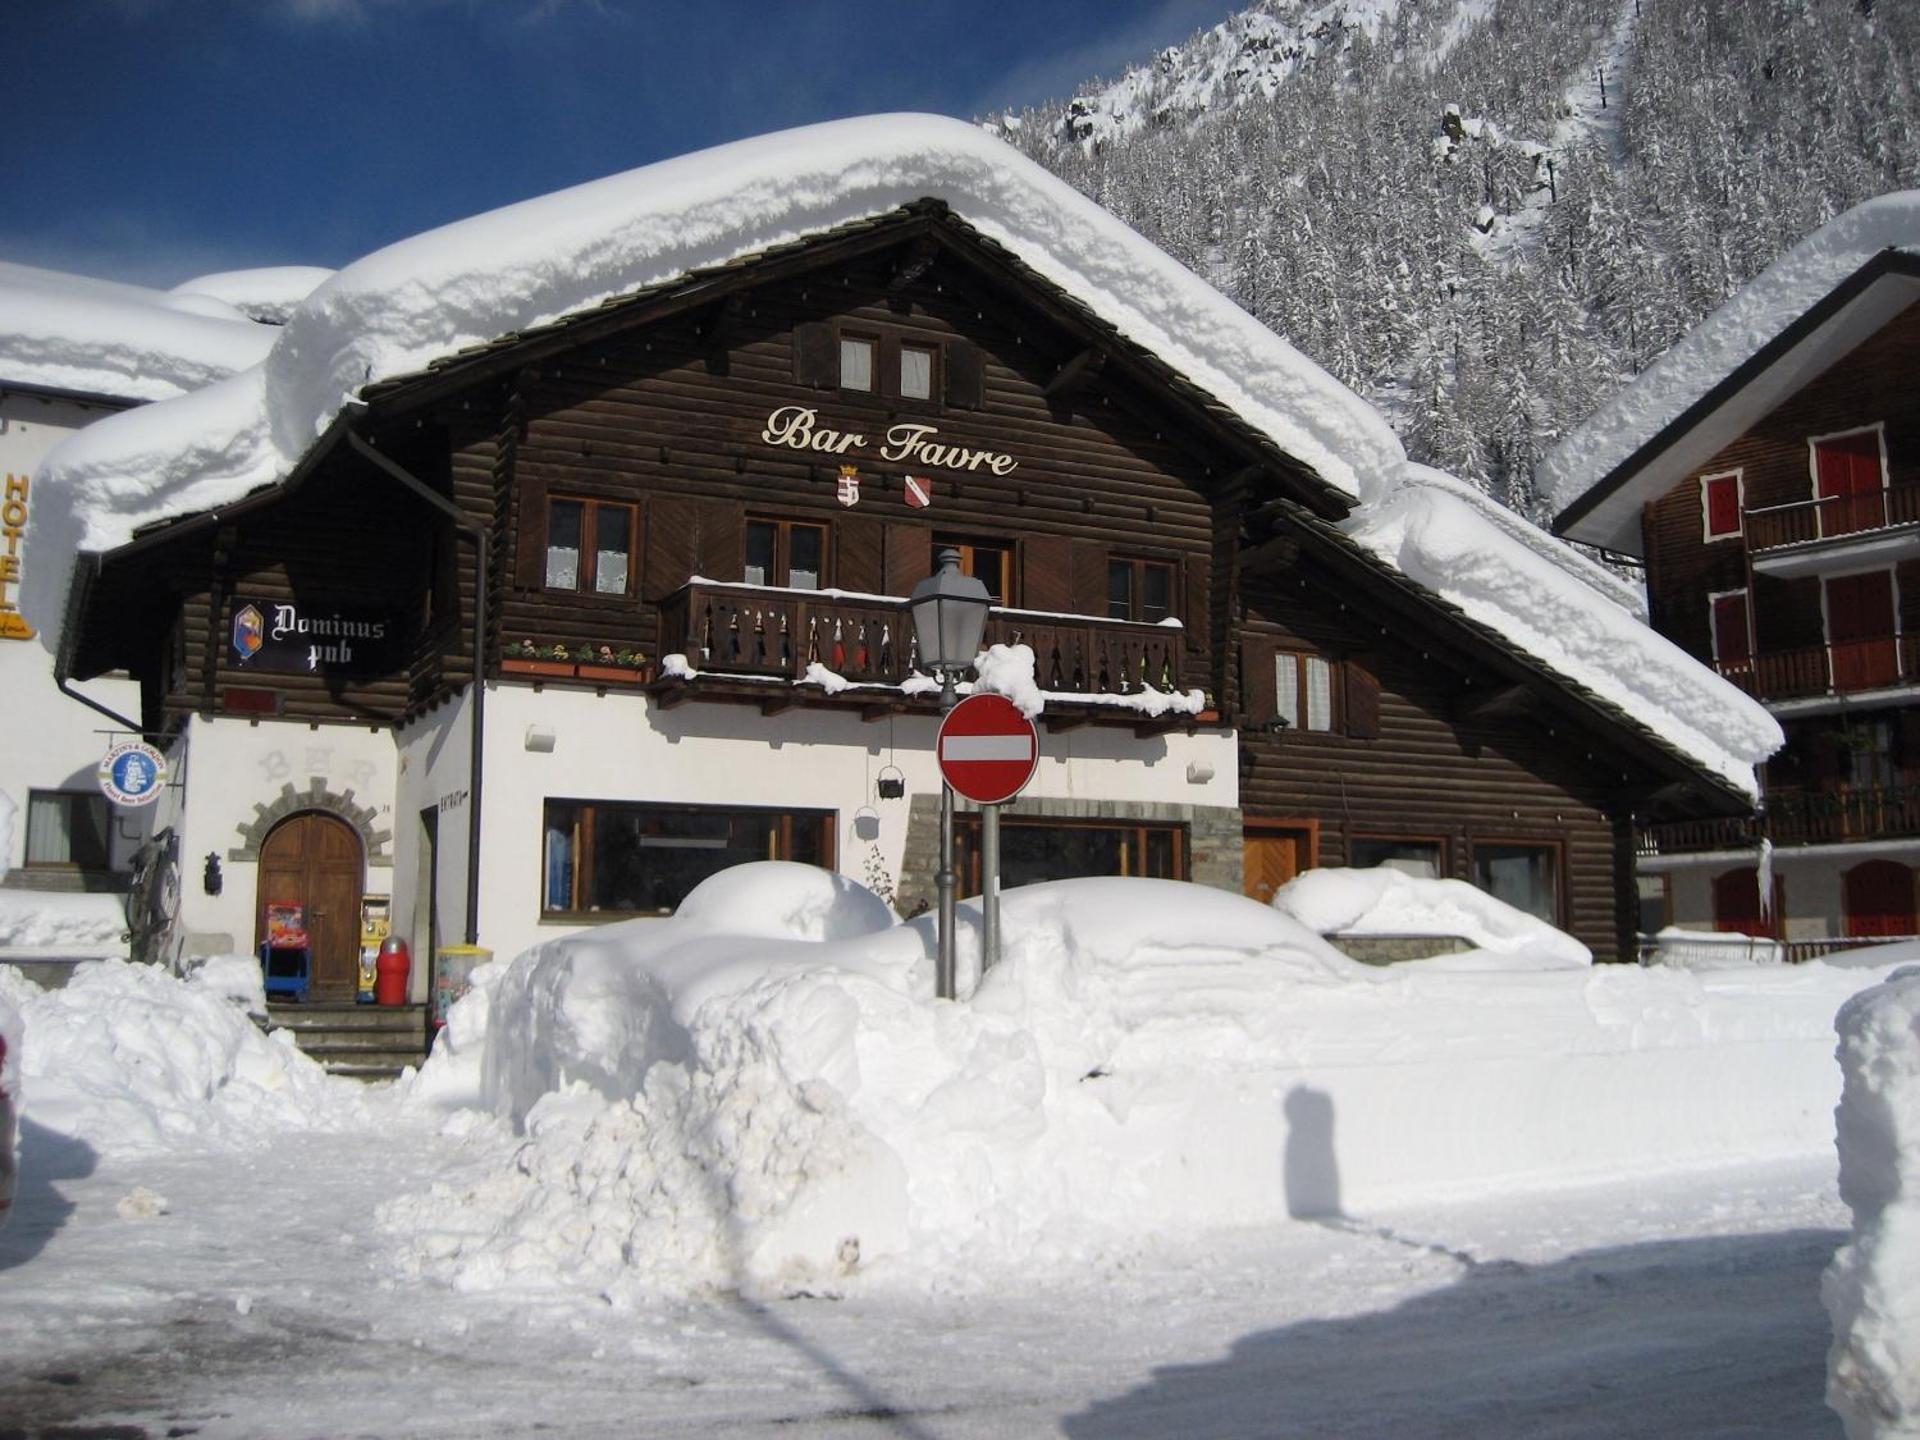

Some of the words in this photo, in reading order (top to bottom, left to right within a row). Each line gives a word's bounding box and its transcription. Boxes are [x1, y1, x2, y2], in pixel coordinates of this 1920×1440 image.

[762, 406, 868, 454] Bar
[880, 423, 1019, 476] Favre
[0, 472, 29, 611] HOTEL
[271, 604, 385, 641] Dominus
[307, 640, 351, 671] pub
